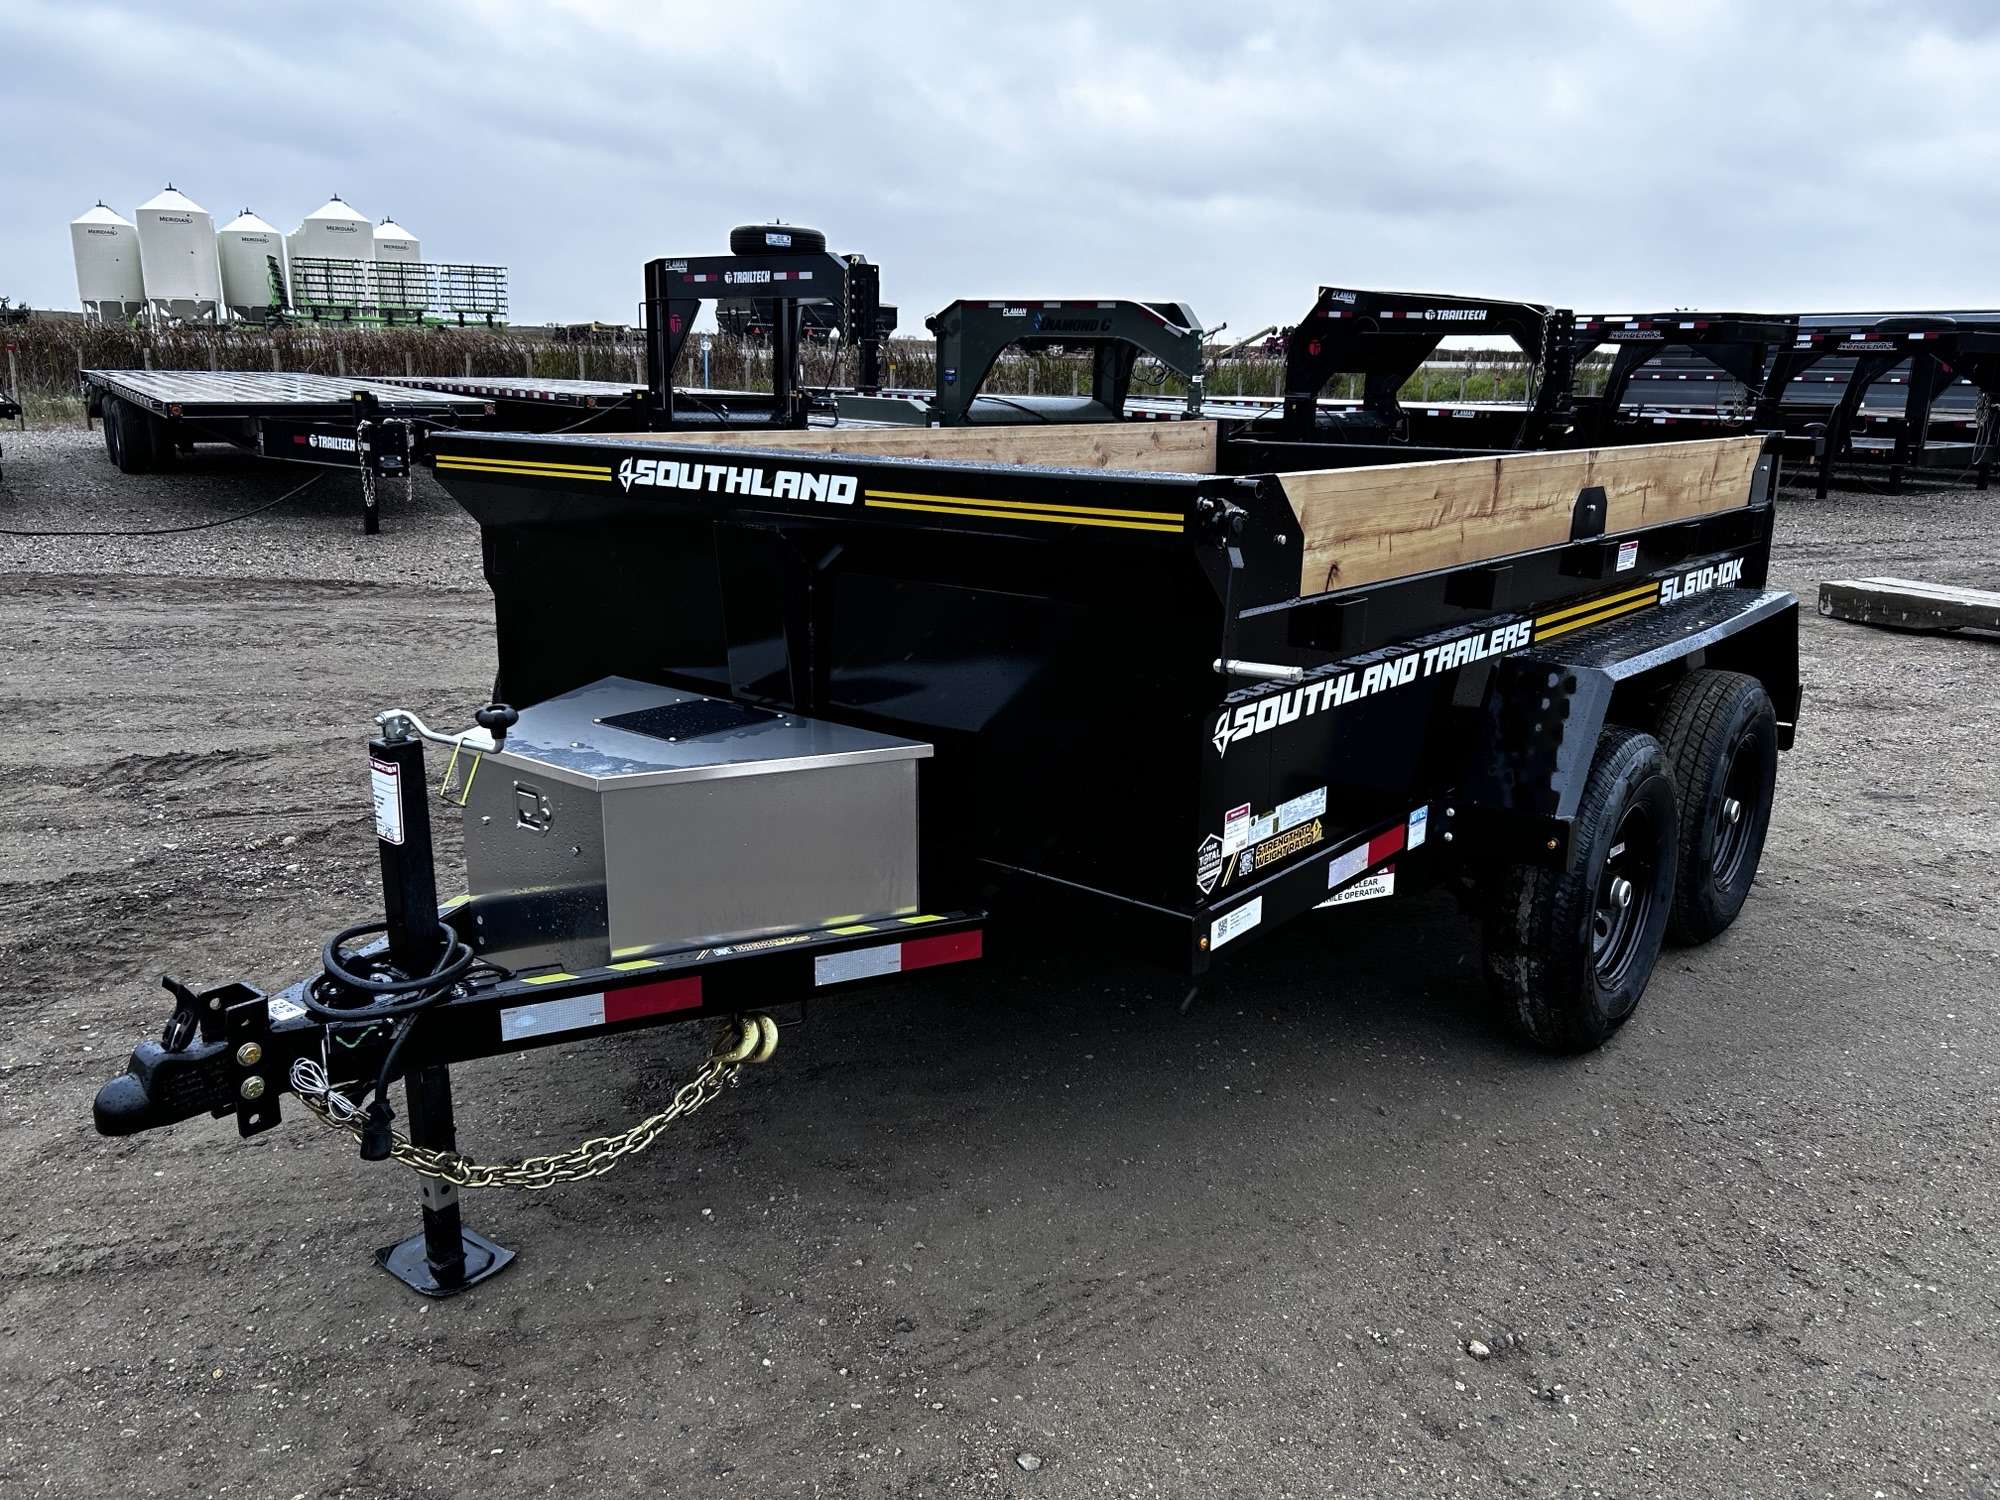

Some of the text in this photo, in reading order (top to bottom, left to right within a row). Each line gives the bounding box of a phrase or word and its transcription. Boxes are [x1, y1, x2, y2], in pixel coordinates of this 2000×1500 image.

[159, 216, 190, 224] MERIDIAN
[665, 260, 688, 269] FLAMAN
[733, 270, 771, 284] TRAILTECH
[1332, 291, 1356, 300] FLAMAN
[1436, 310, 1487, 321] TRAILTECH
[318, 435, 356, 452] TRAILTECH
[634, 459, 858, 505] SOUTHLAND
[1660, 557, 1744, 607] SL610-10K
[1231, 619, 1533, 742] SOUTHLAND TRAILERS
[1257, 830, 1299, 855] STRENGTH
[1300, 824, 1312, 836] TO
[1199, 849, 1221, 867] TOTAL
[1256, 834, 1313, 867] WEIGHT RATIO
[1344, 886, 1386, 899] OPERATING
